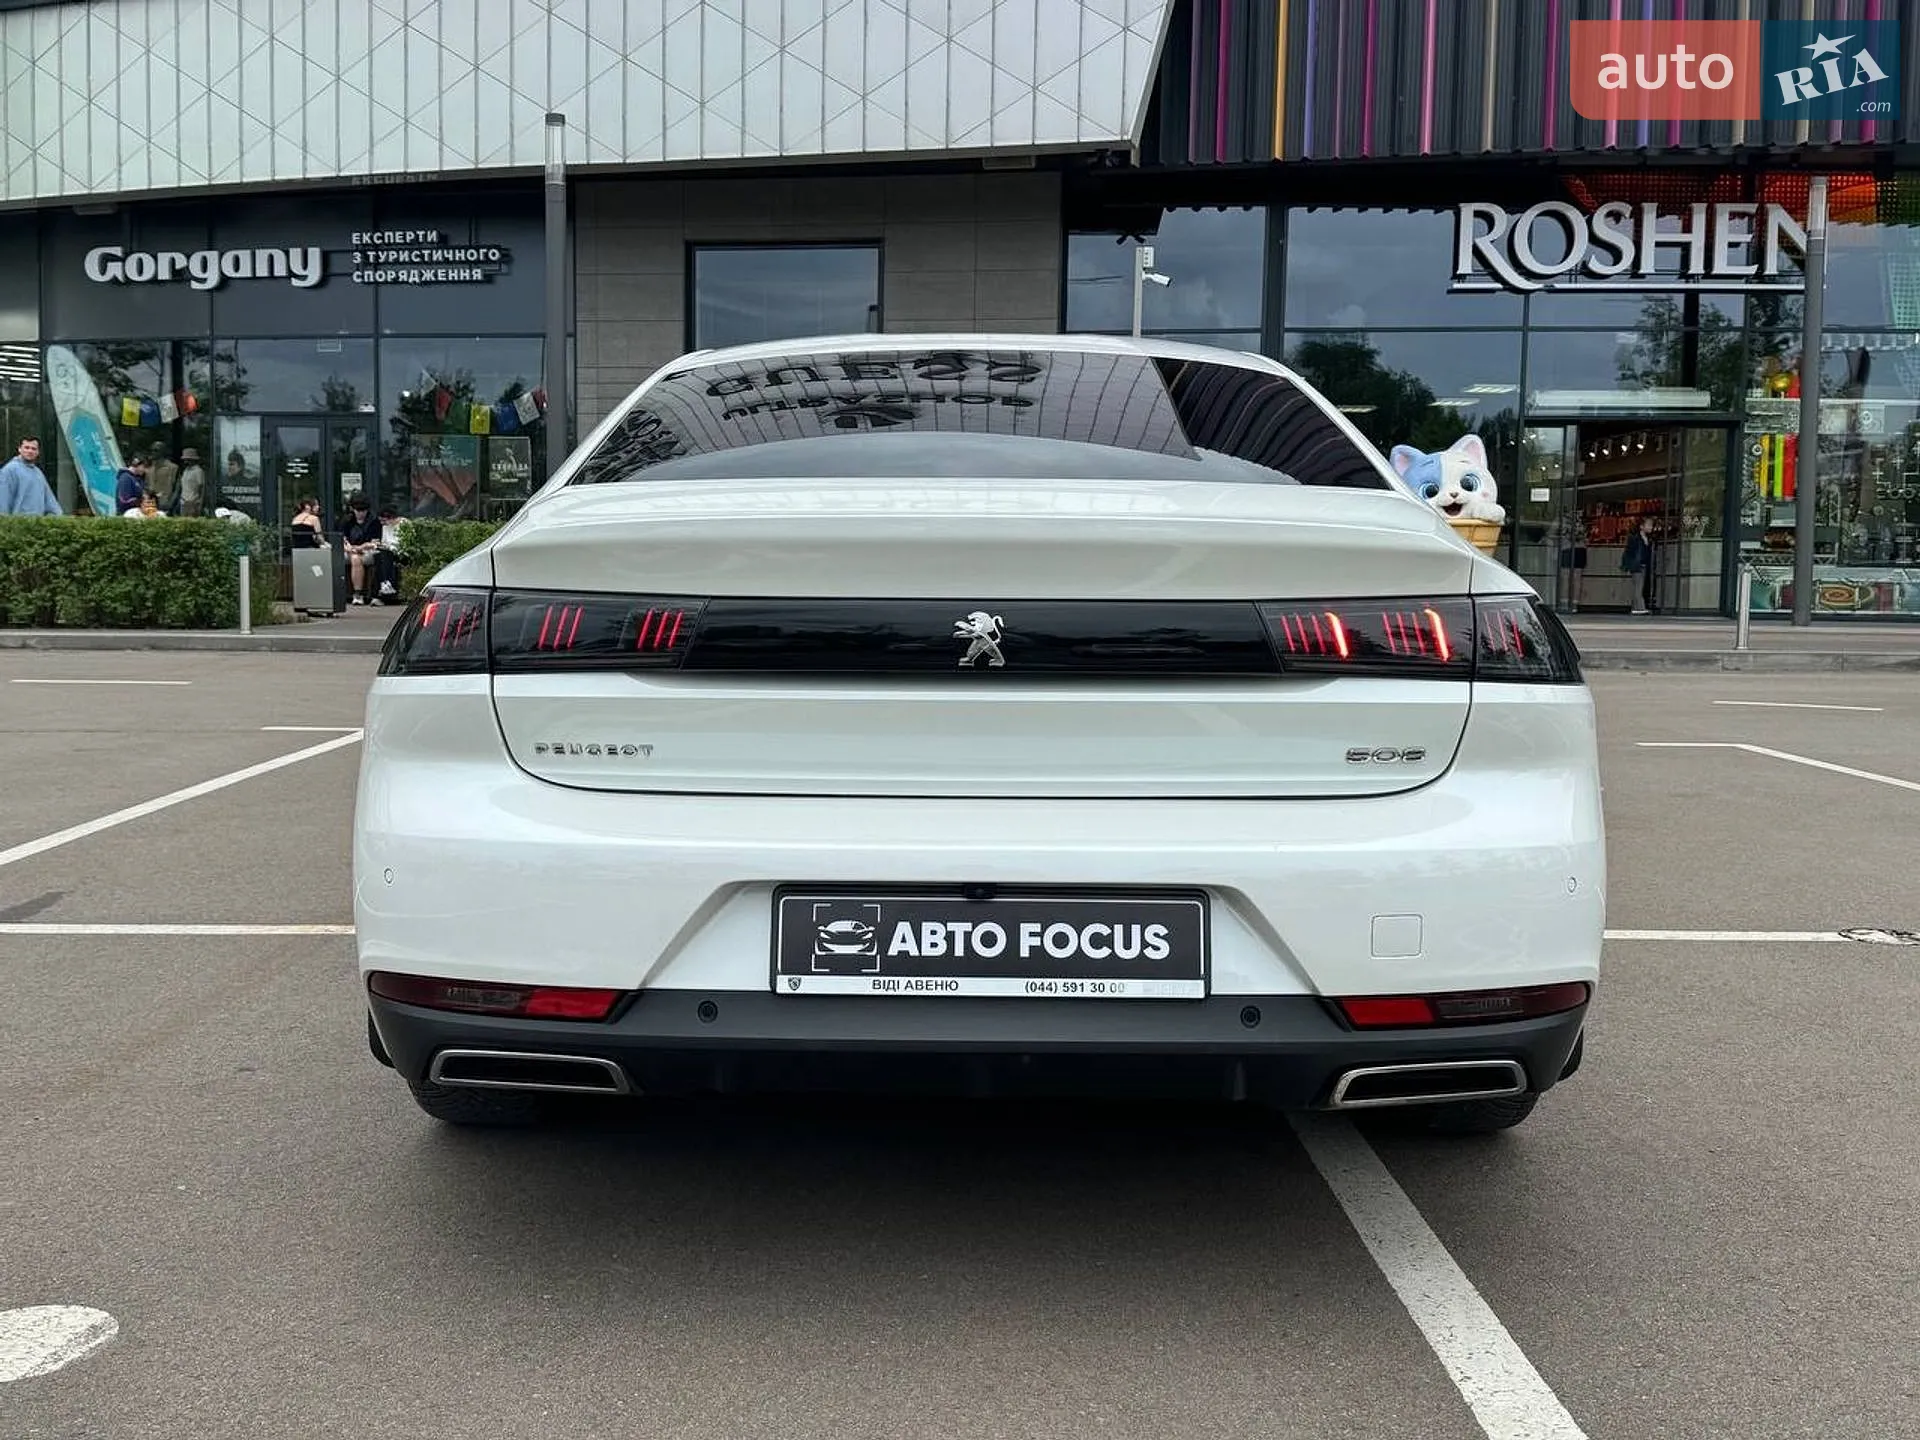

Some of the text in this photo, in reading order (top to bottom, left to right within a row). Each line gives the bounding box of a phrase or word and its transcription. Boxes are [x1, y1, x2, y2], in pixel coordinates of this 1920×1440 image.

[352, 230, 438, 245] ЕКСПЕРТИ
[1456, 200, 1809, 290] ROSHEN
[367, 248, 501, 264] ТУРИСТИЧНОГО
[84, 246, 322, 290] Gorgany
[352, 268, 482, 284] СПОРЯДЖЕННЯ
[534, 743, 654, 756] PEUGEOT
[887, 920, 1170, 961] АВТО FOCUS
[872, 979, 959, 993] ВІДІ АВЕНЮ
[1024, 981, 1059, 995] (044)
[1062, 982, 1086, 993] 591
[1090, 982, 1106, 993] 30
